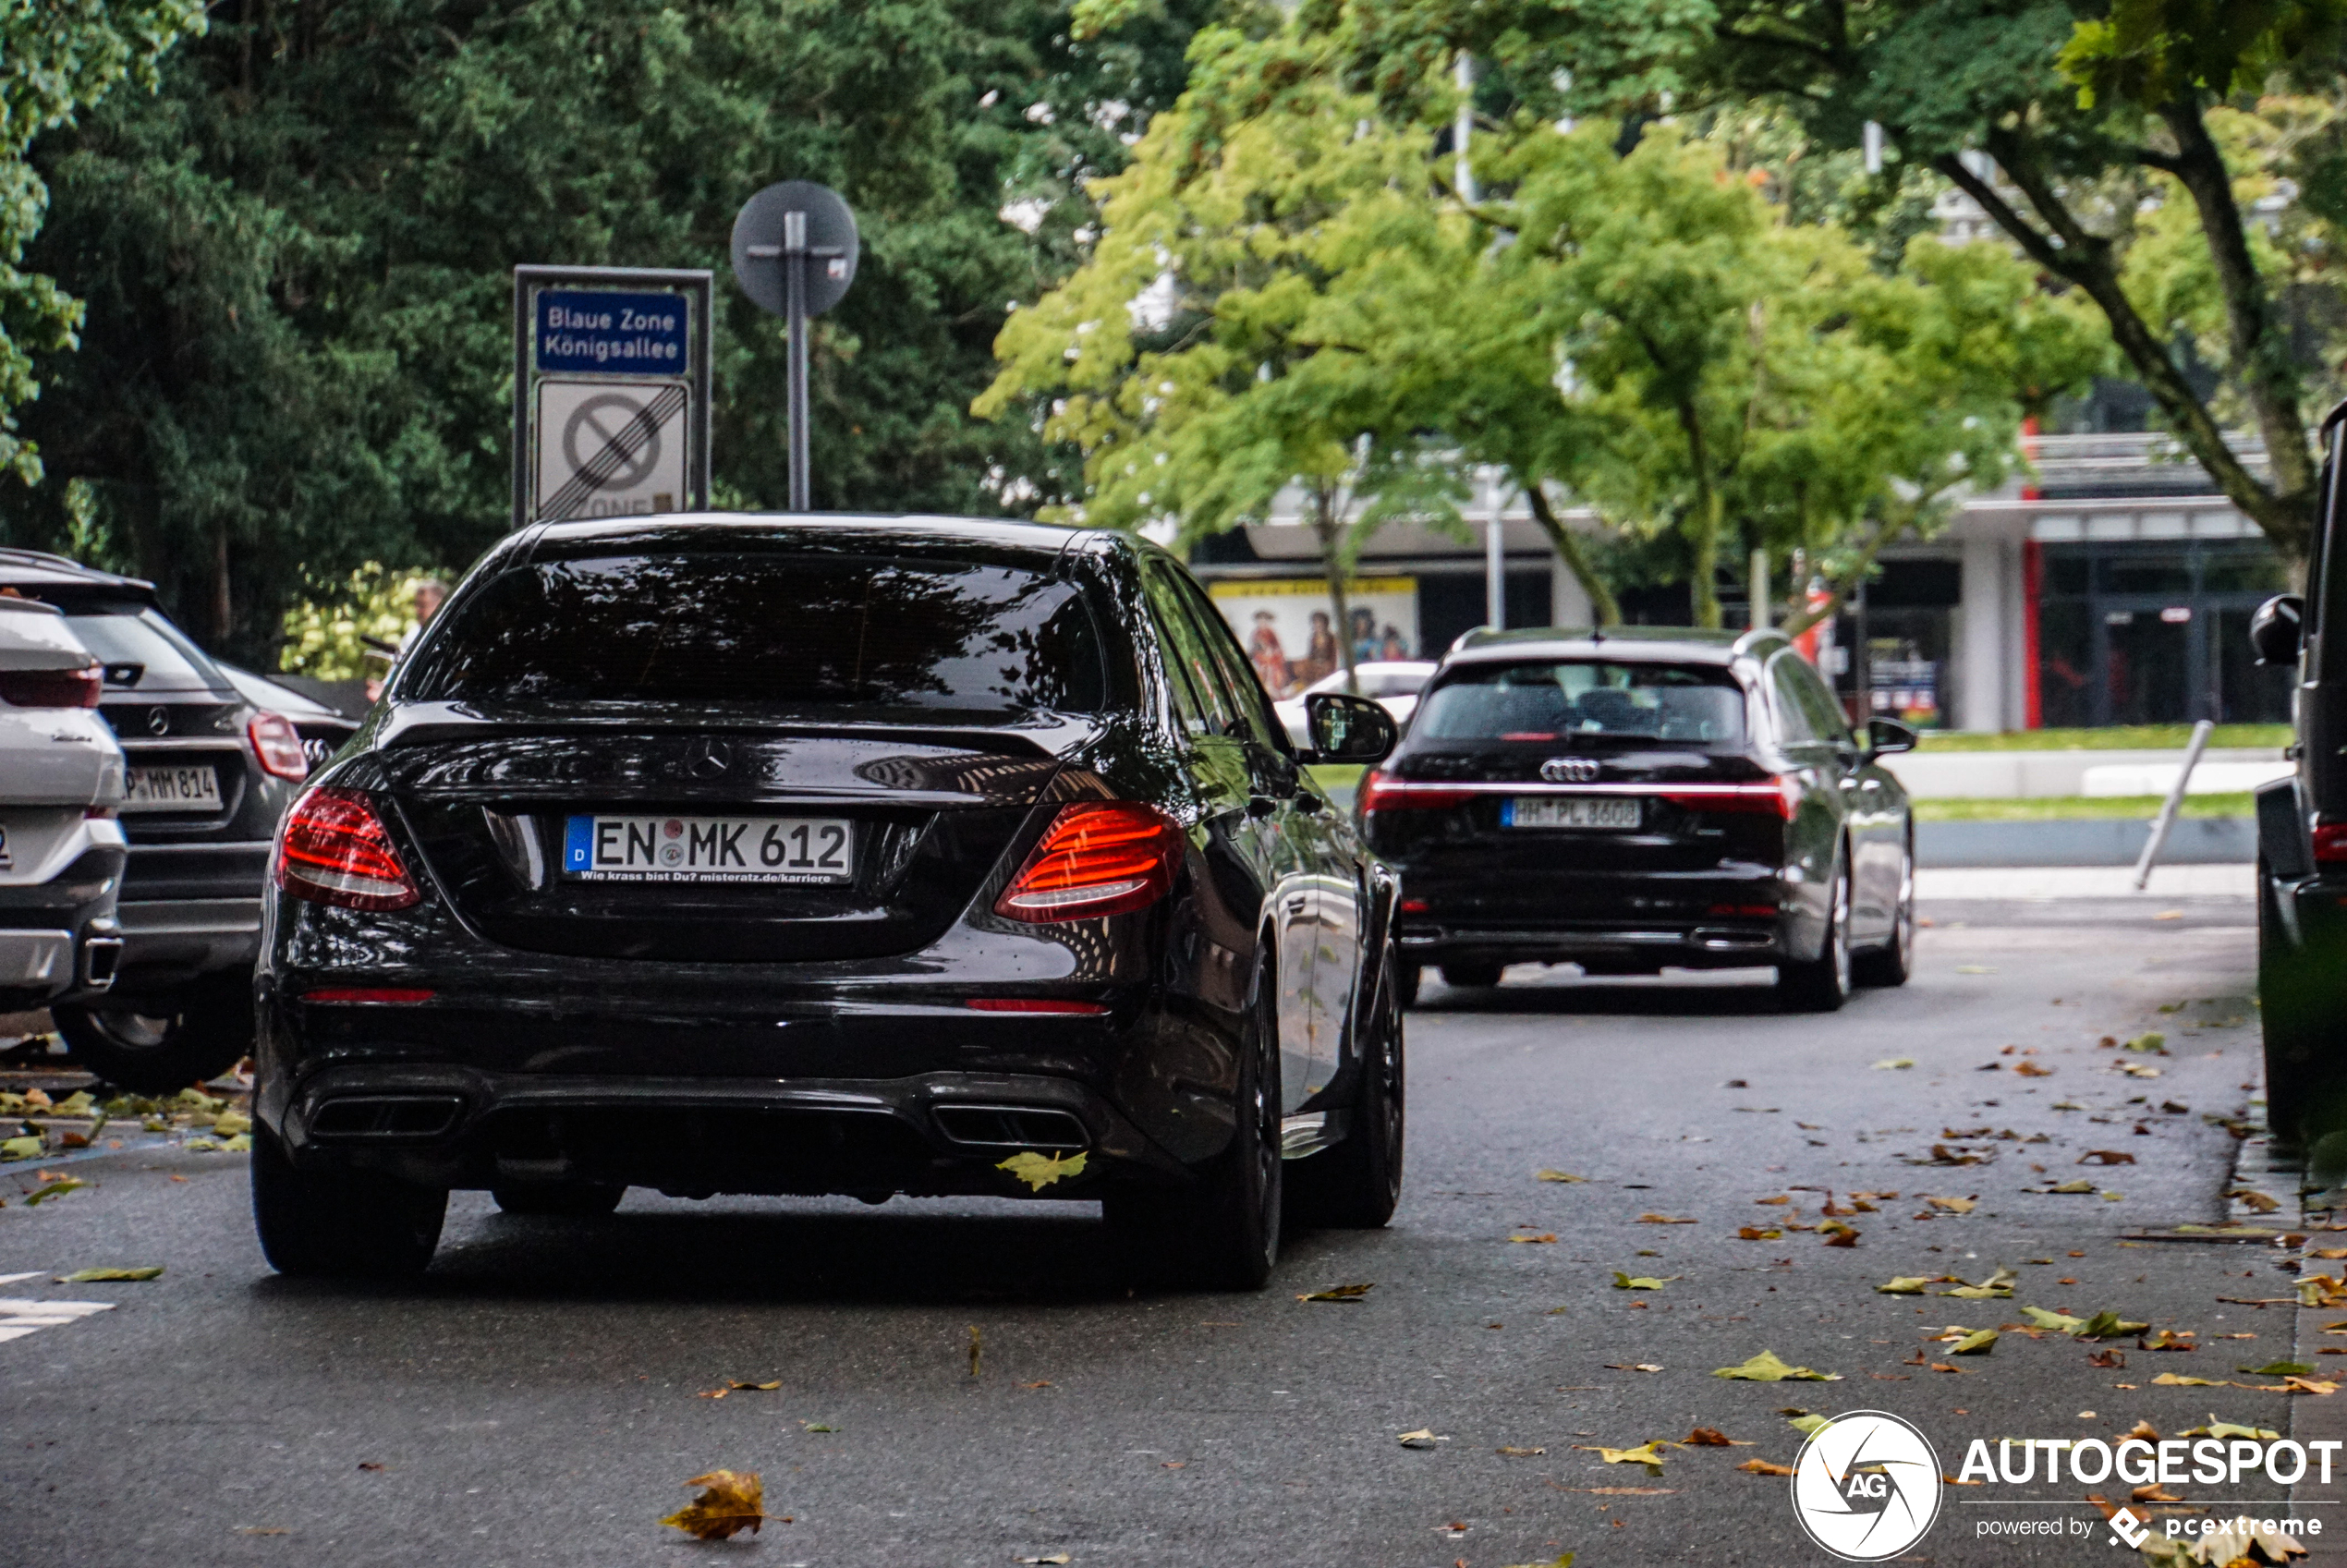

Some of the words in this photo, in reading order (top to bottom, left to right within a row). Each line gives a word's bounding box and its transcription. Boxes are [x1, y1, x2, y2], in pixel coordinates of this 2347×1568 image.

[548, 307, 612, 330] Blaue
[619, 308, 675, 332] Zone
[545, 334, 678, 362] Königsallee
[178, 770, 213, 798] 814
[574, 849, 585, 862] D
[596, 821, 656, 866] EN
[688, 823, 748, 867] MK
[760, 824, 846, 869] 612
[580, 870, 605, 881] Wie
[607, 871, 643, 881] krass
[645, 871, 670, 881] bist
[673, 872, 698, 882] Du?
[699, 873, 832, 884] misteratz.de/karriere
